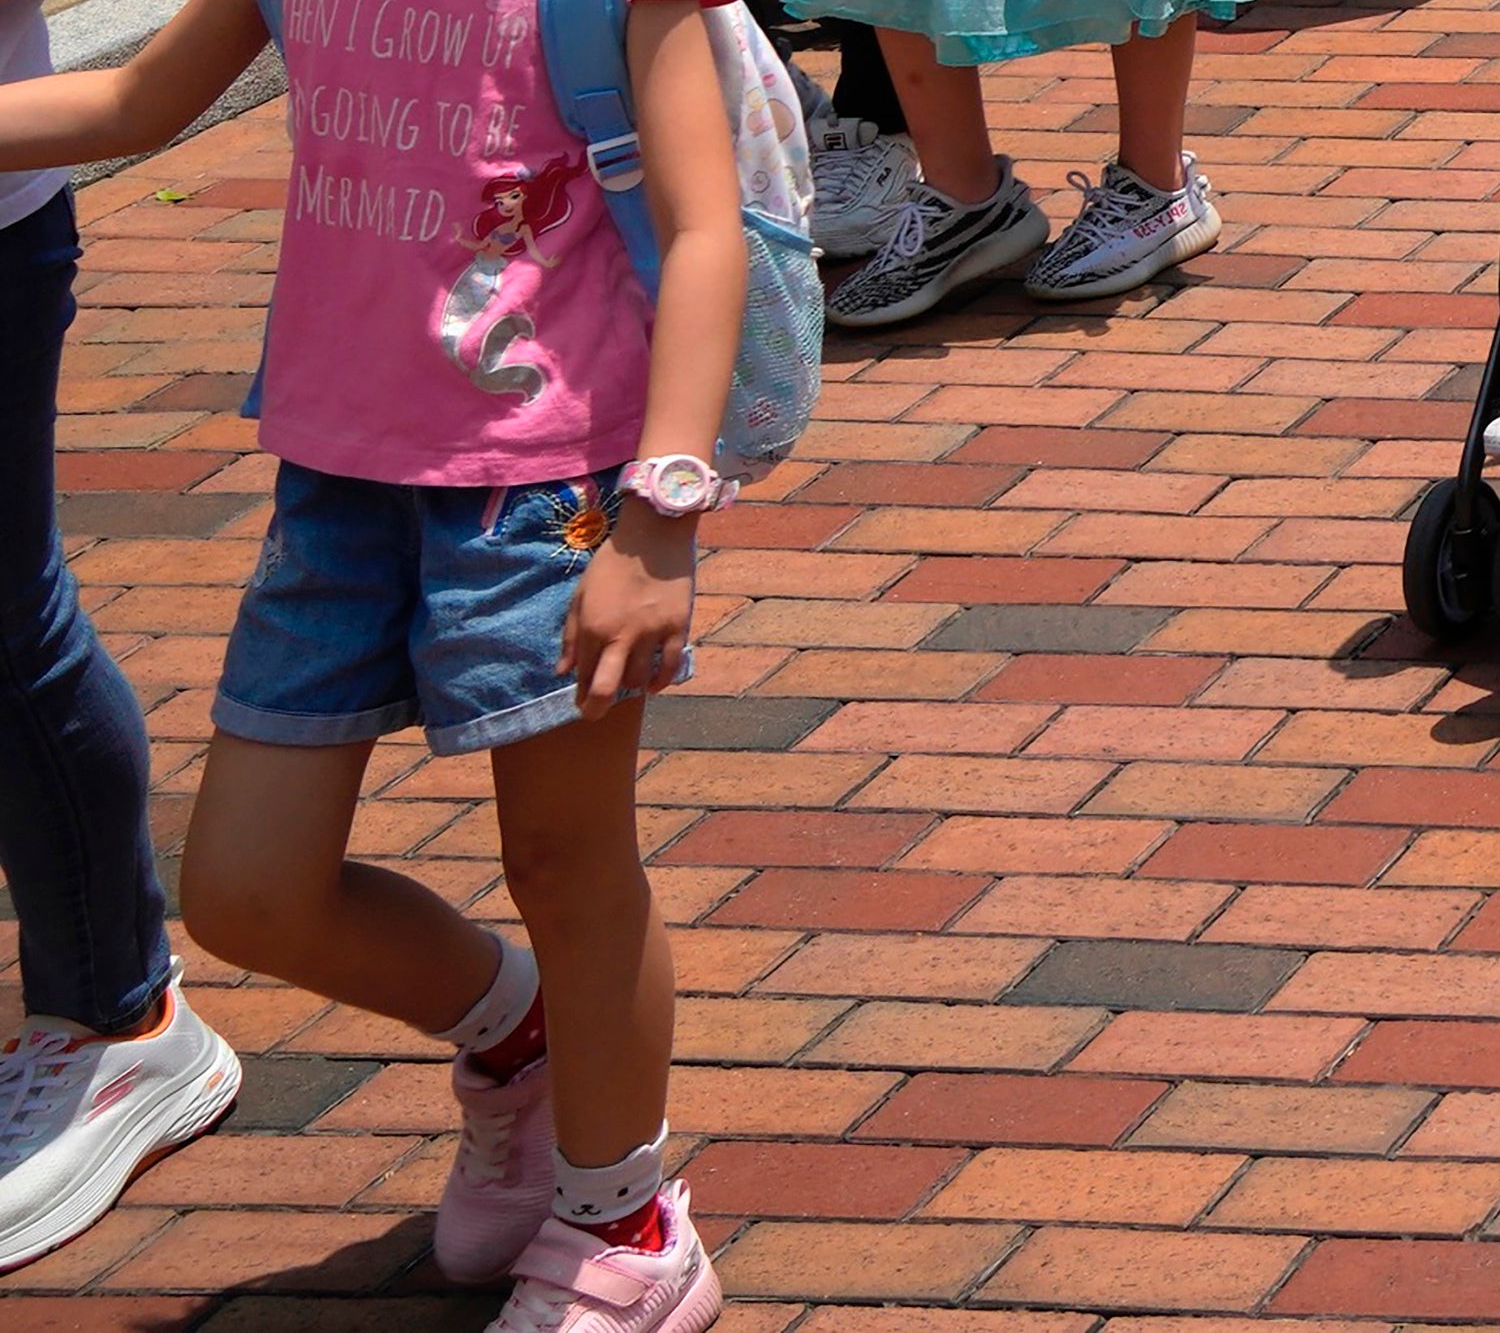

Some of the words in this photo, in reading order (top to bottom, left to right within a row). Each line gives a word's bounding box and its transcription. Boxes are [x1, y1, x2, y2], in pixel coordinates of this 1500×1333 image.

[481, 13, 529, 69] UP
[310, 84, 420, 151] GOING
[436, 100, 473, 157] TO
[483, 104, 527, 158] BE
[296, 164, 446, 242] MERMAID
